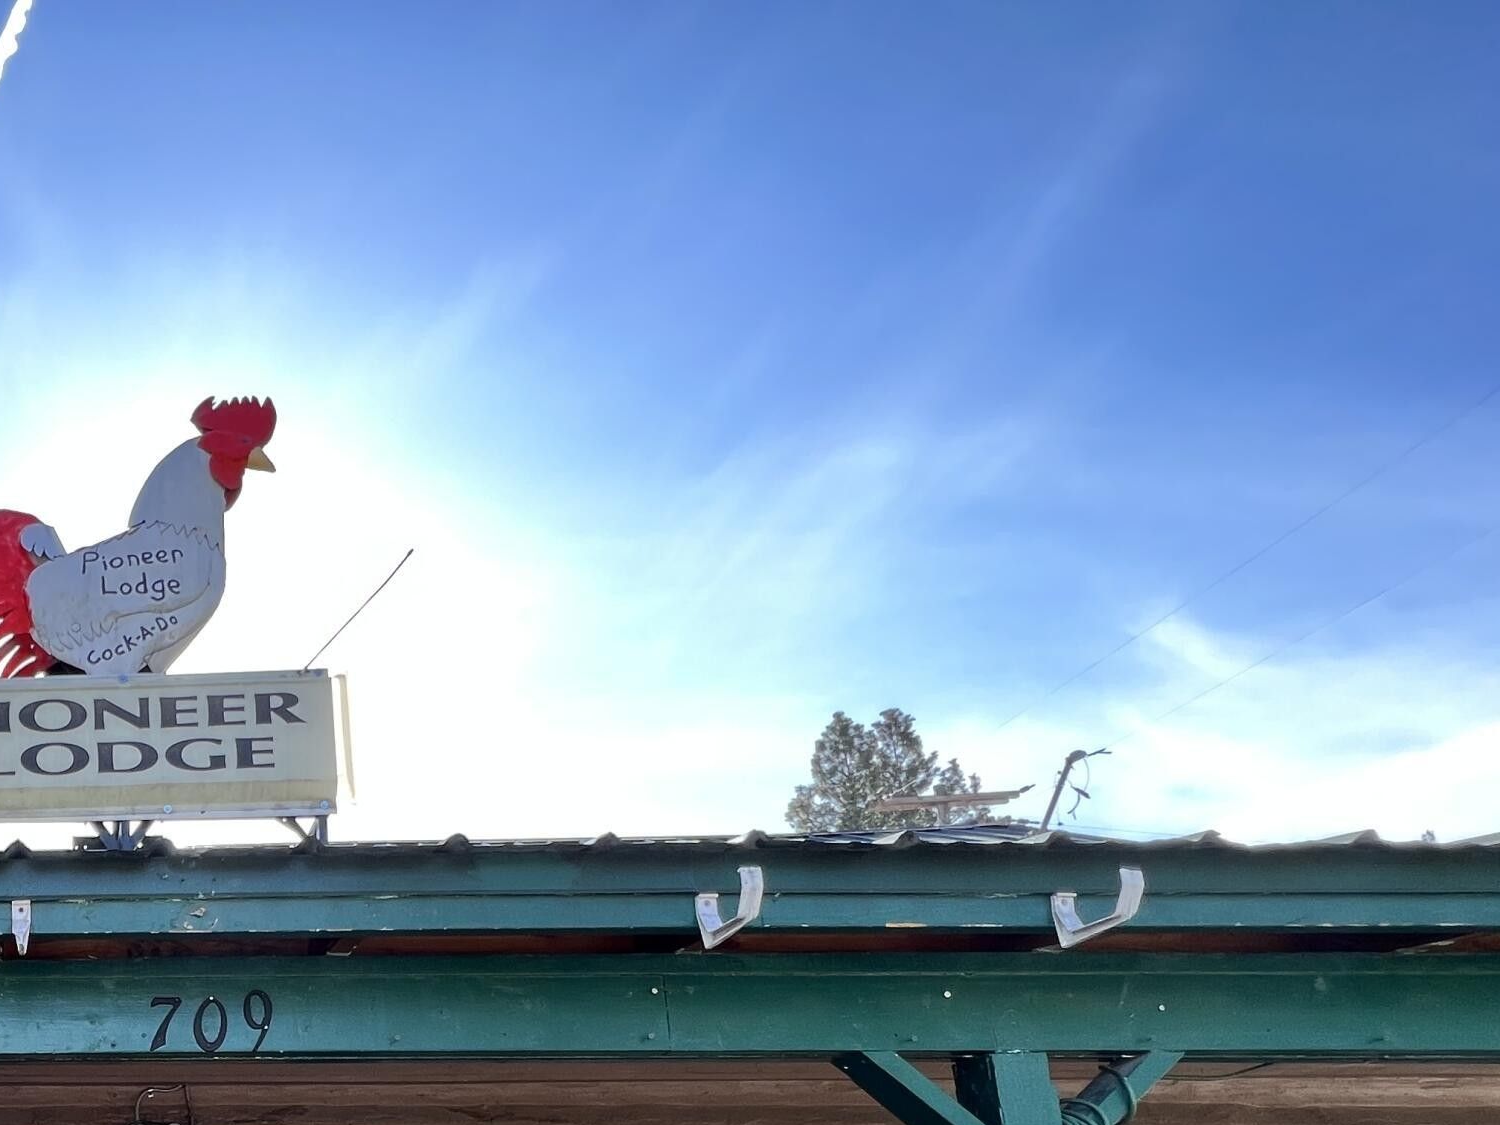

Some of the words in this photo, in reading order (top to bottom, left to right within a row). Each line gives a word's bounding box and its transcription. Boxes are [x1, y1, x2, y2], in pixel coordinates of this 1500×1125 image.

[101, 572, 181, 602] Lodge
[86, 615, 179, 665] Cock-A-Do
[150, 989, 273, 1052] 709
